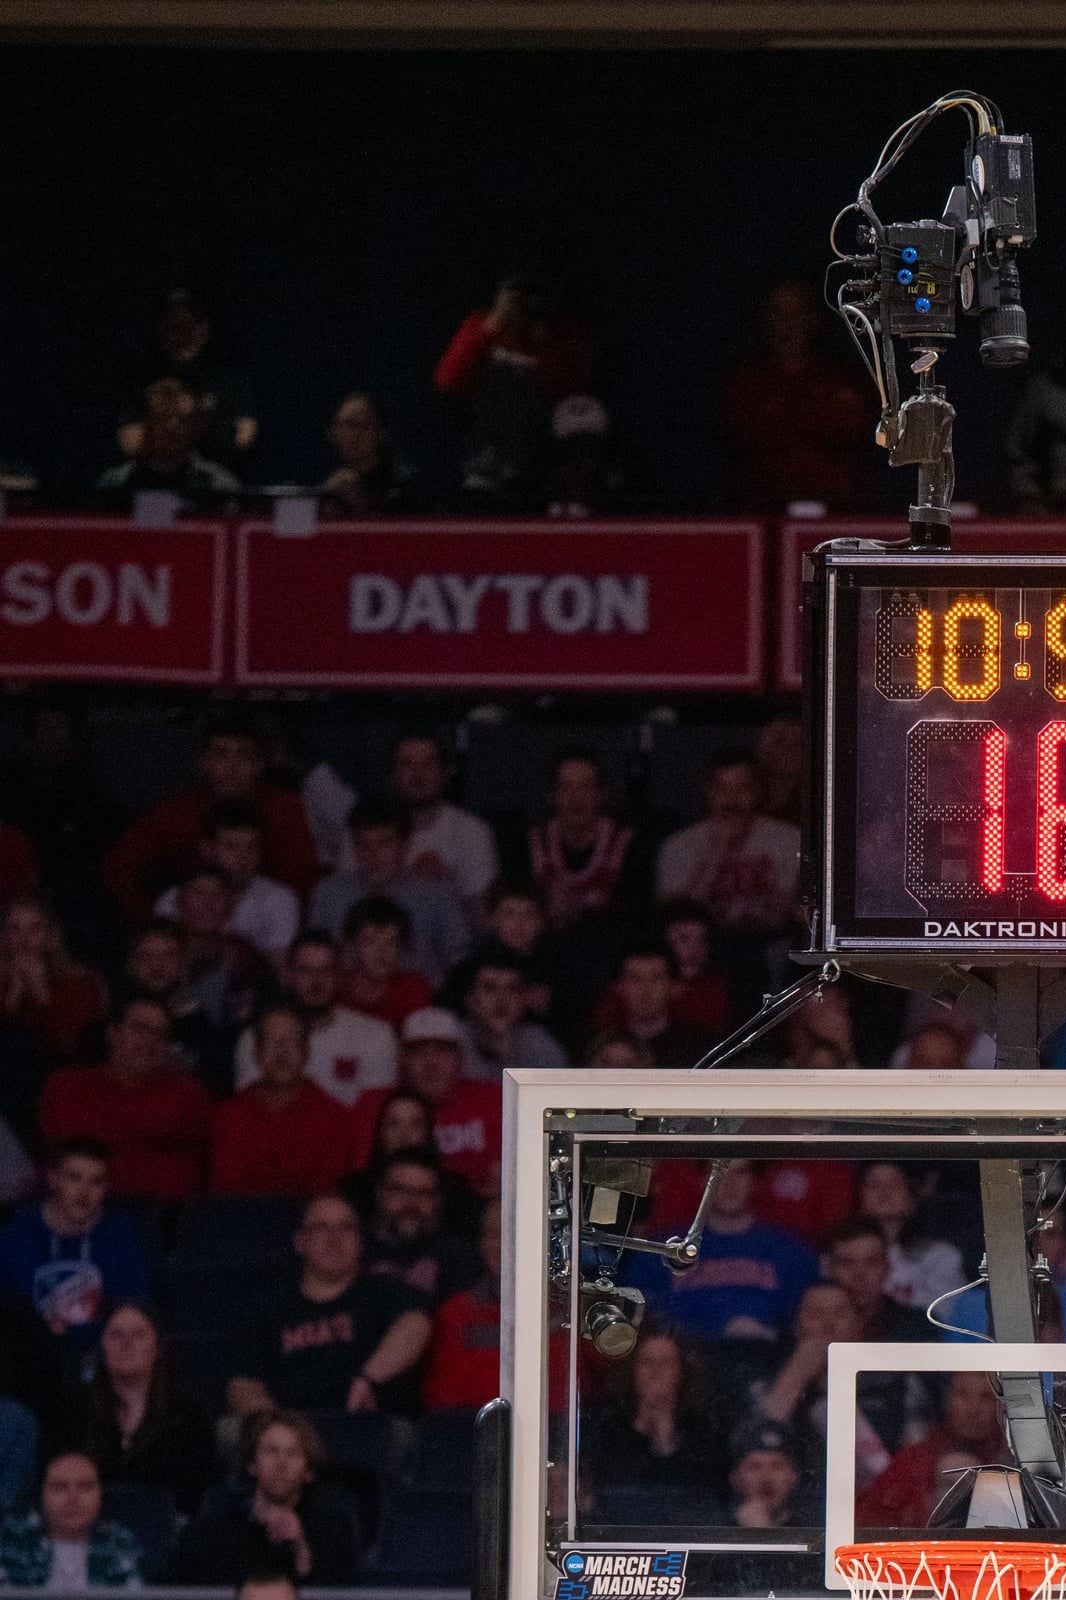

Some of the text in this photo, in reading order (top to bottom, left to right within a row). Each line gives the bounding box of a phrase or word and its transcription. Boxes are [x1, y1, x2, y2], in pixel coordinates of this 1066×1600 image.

[2, 562, 172, 627] SON
[349, 575, 648, 634] DAYTON
[584, 1556, 652, 1575] MARCH
[591, 1576, 682, 1596] MADNESS
